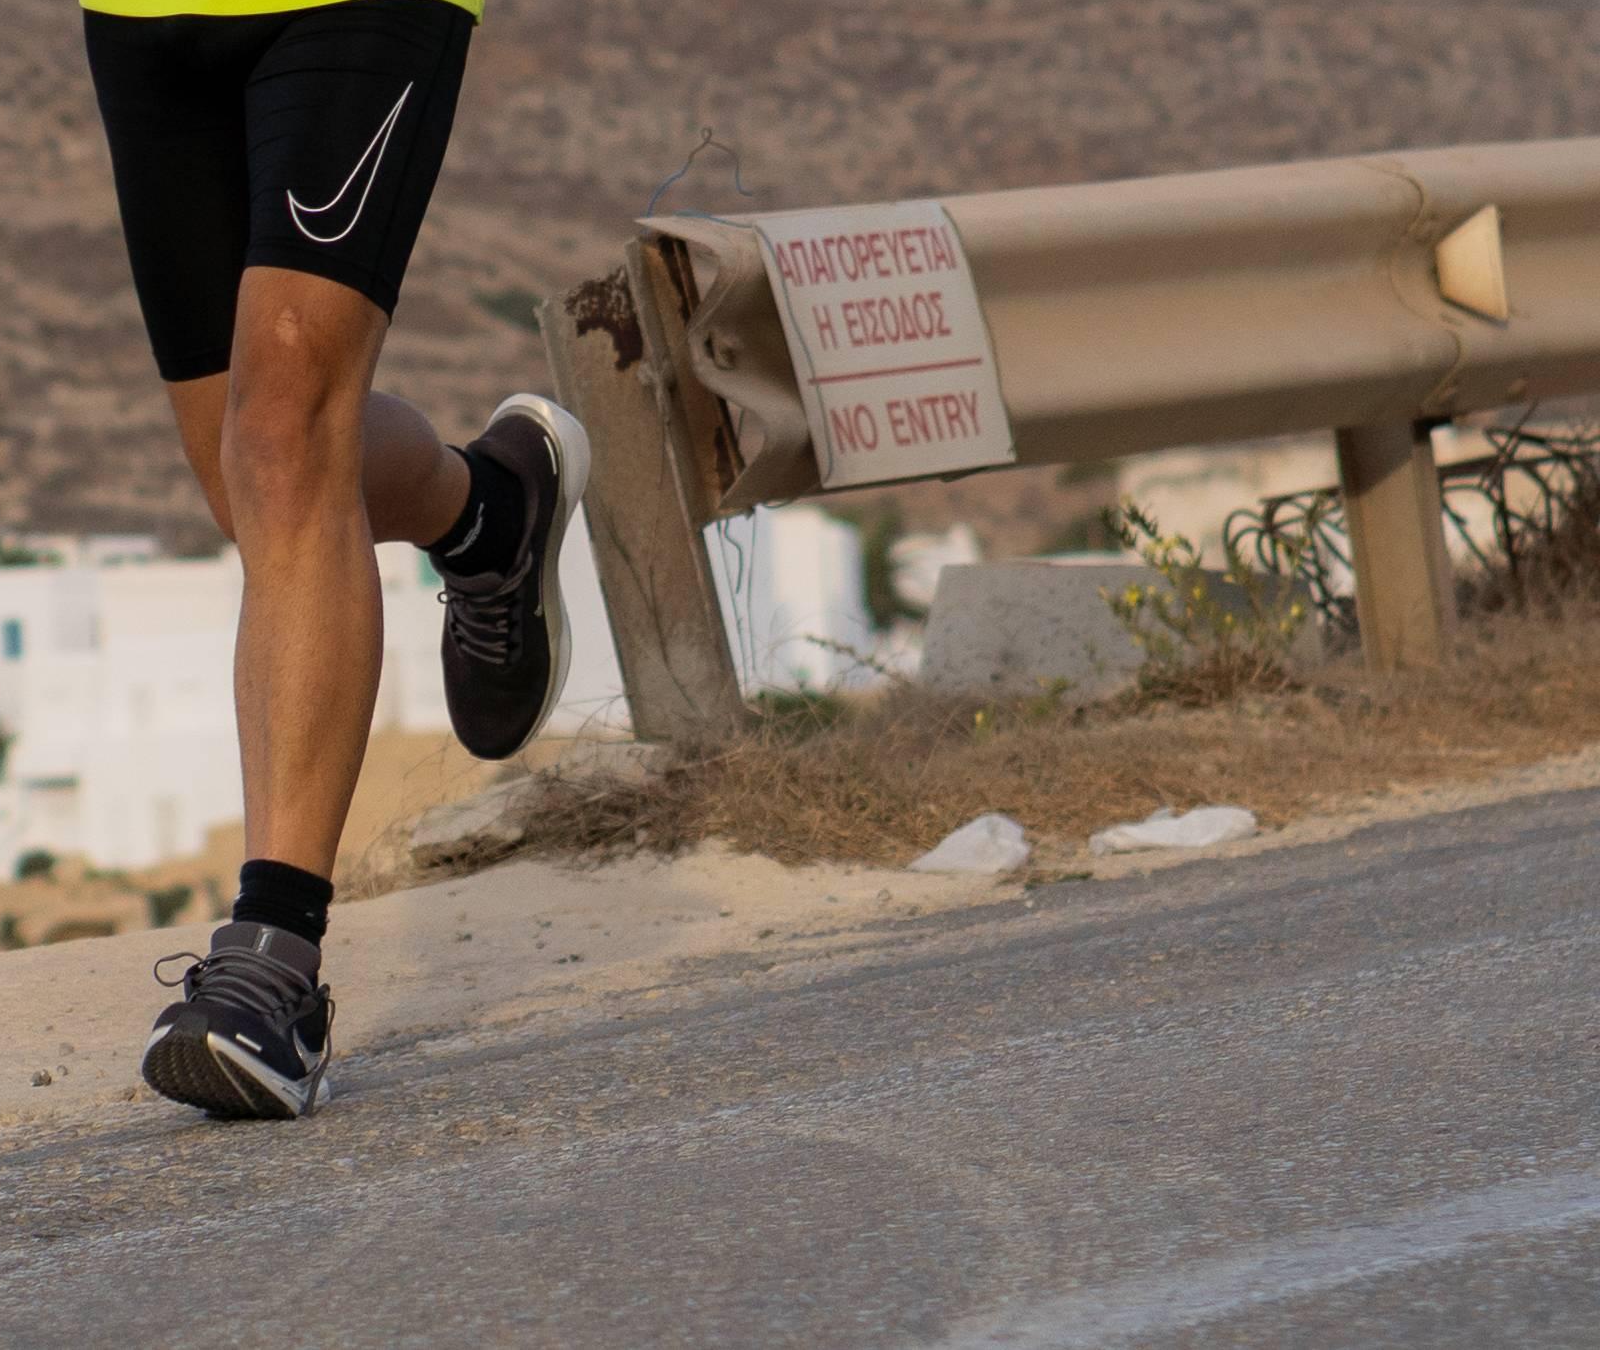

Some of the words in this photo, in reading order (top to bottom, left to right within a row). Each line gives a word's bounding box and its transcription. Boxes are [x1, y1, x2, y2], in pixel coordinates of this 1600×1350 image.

[775, 226, 958, 288] ΑΠΑΓΟΡΕΥΕΤΑΙ
[812, 304, 838, 351] Η
[841, 291, 952, 348] ΕΙΣΟΔΟΣ
[830, 403, 879, 455] NO
[886, 391, 981, 448] ENTRY
